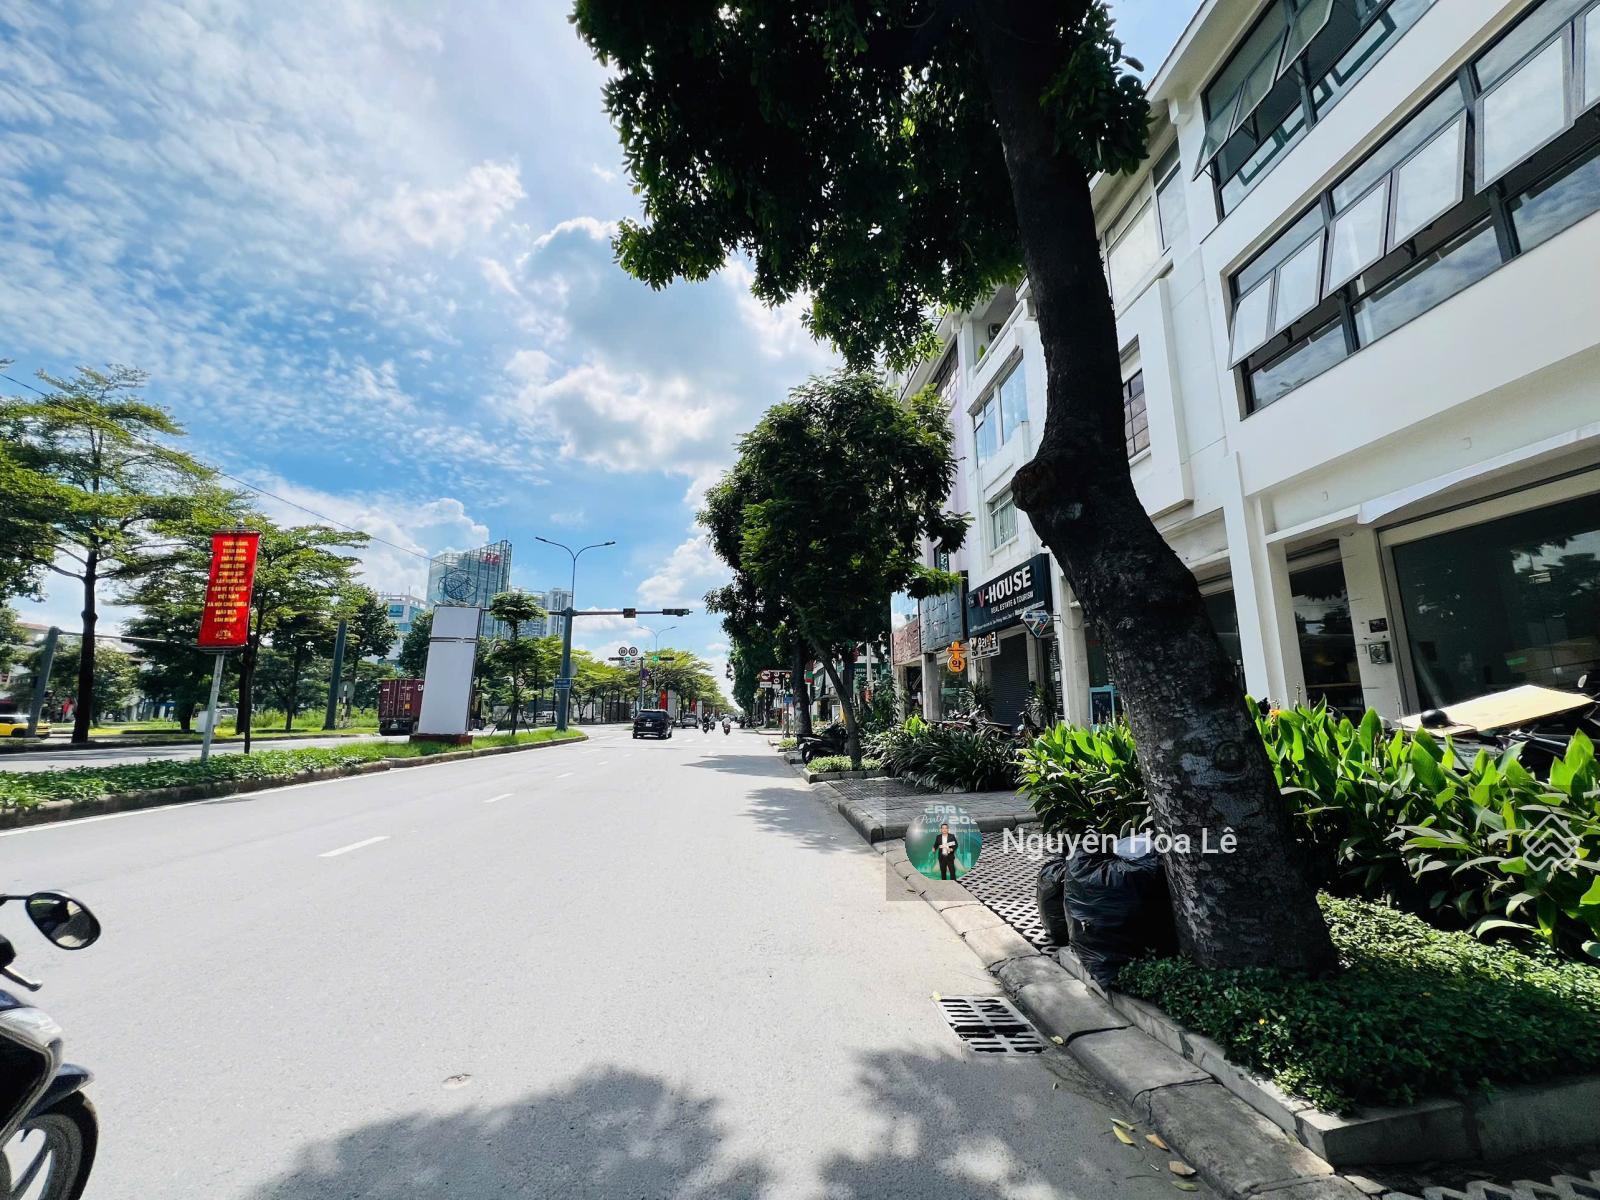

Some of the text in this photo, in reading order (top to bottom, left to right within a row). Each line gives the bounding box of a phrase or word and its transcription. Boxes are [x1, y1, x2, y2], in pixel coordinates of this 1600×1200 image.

[978, 565, 1032, 607] V-HOUSE
[1000, 599, 1014, 610] ESTATE
[1017, 591, 1034, 604] TOURISM
